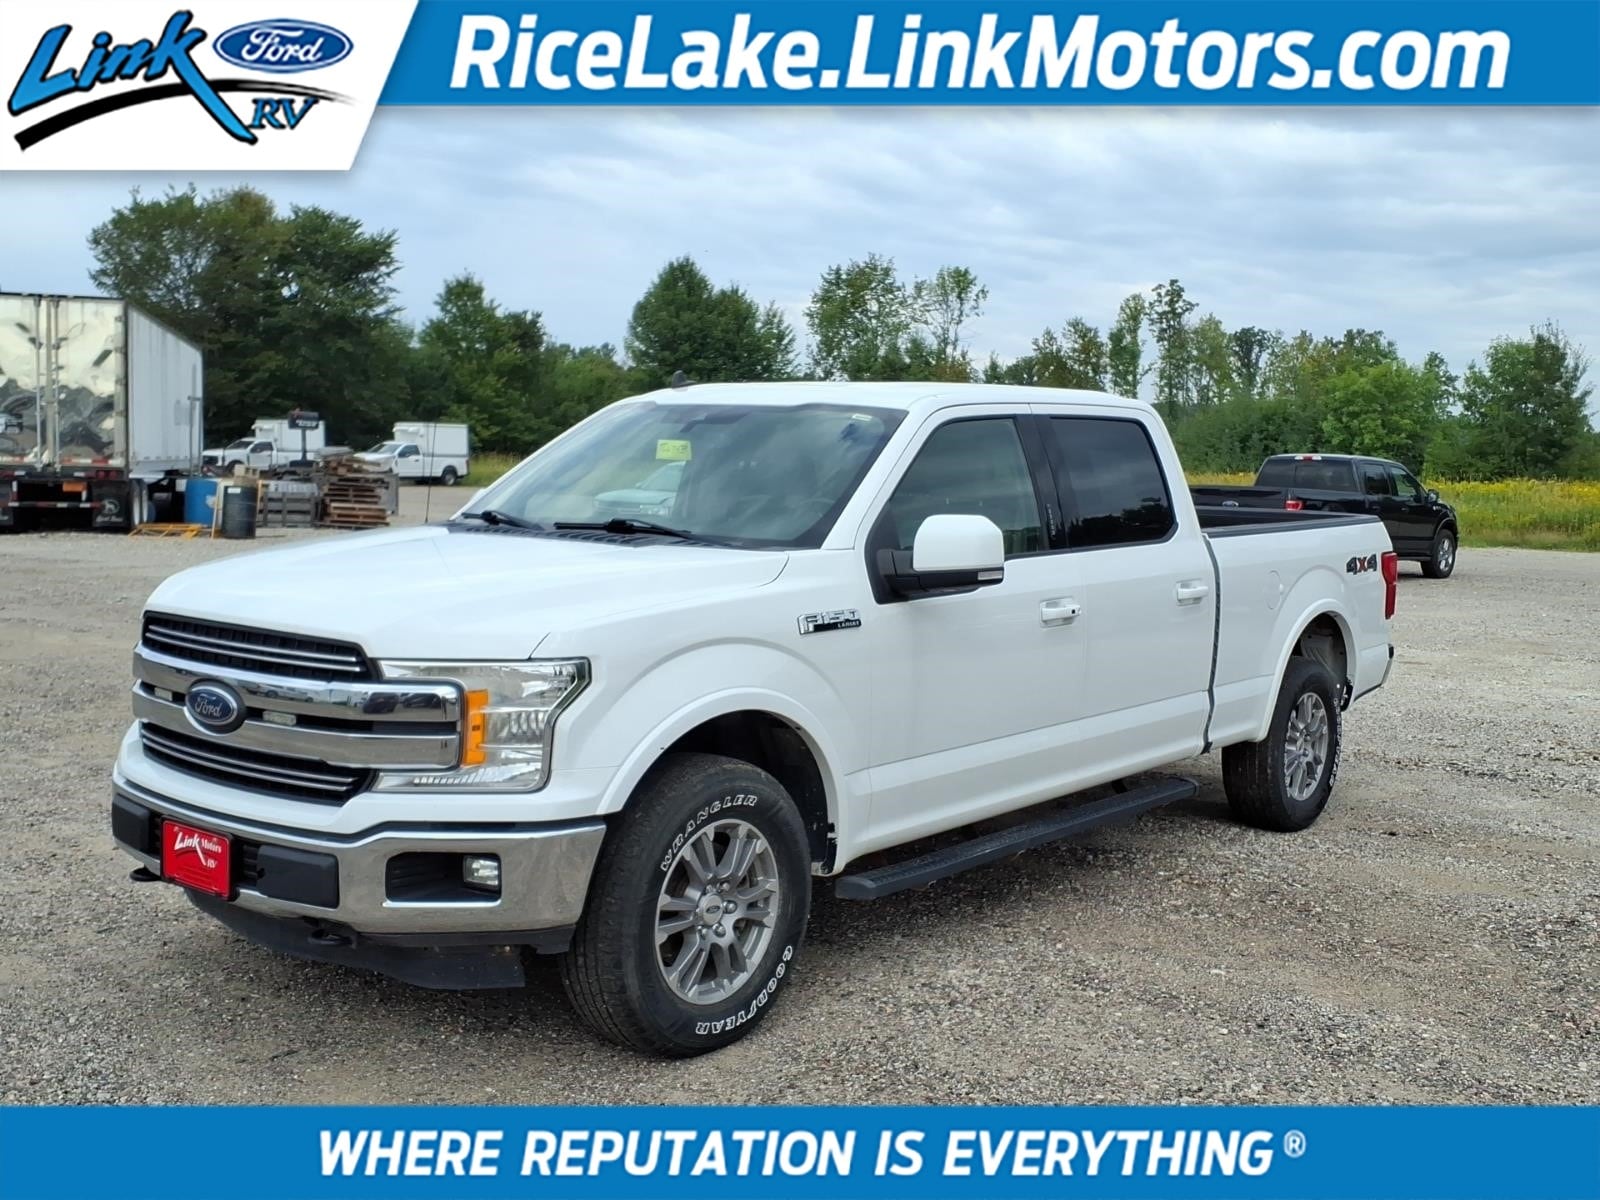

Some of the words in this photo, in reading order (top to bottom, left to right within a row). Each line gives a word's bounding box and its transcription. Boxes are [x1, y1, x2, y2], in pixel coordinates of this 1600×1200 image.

[195, 693, 223, 717] Ford
[174, 831, 206, 866] Link
[660, 794, 758, 872] WRANGLER
[695, 945, 793, 1035] GOODYEAR
